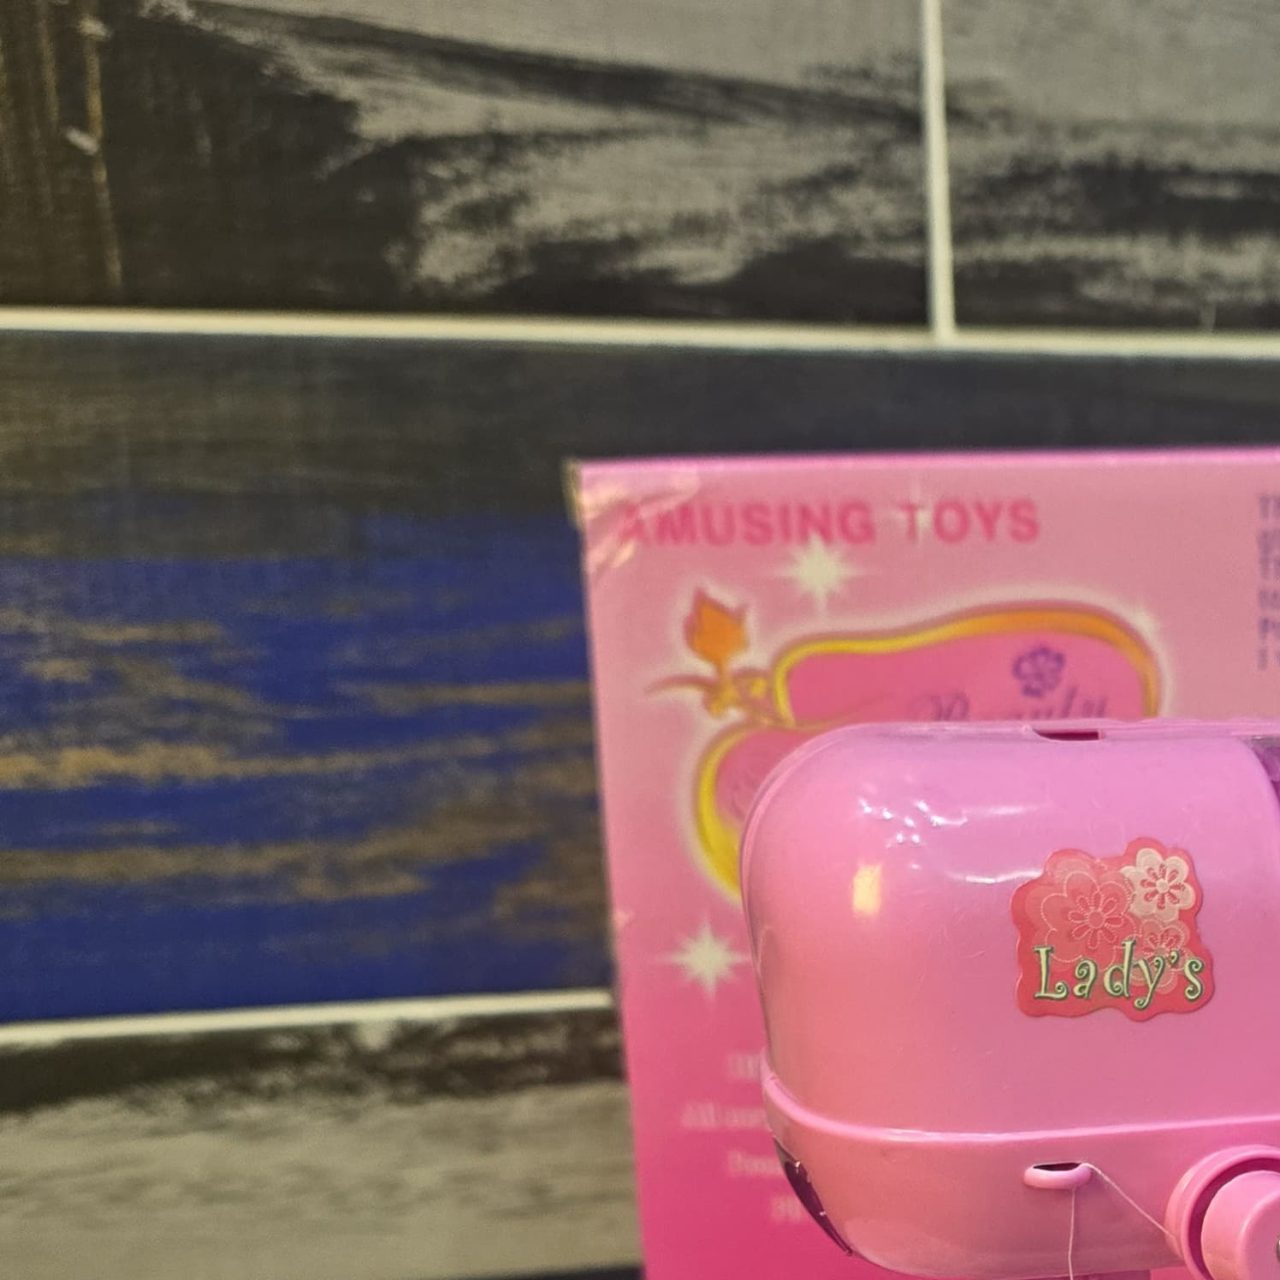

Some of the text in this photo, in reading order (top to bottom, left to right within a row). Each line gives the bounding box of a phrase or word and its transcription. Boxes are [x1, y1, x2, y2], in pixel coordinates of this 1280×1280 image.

[621, 498, 1040, 547] AMUSING TOYS
[1034, 938, 1206, 1009] Lady's
